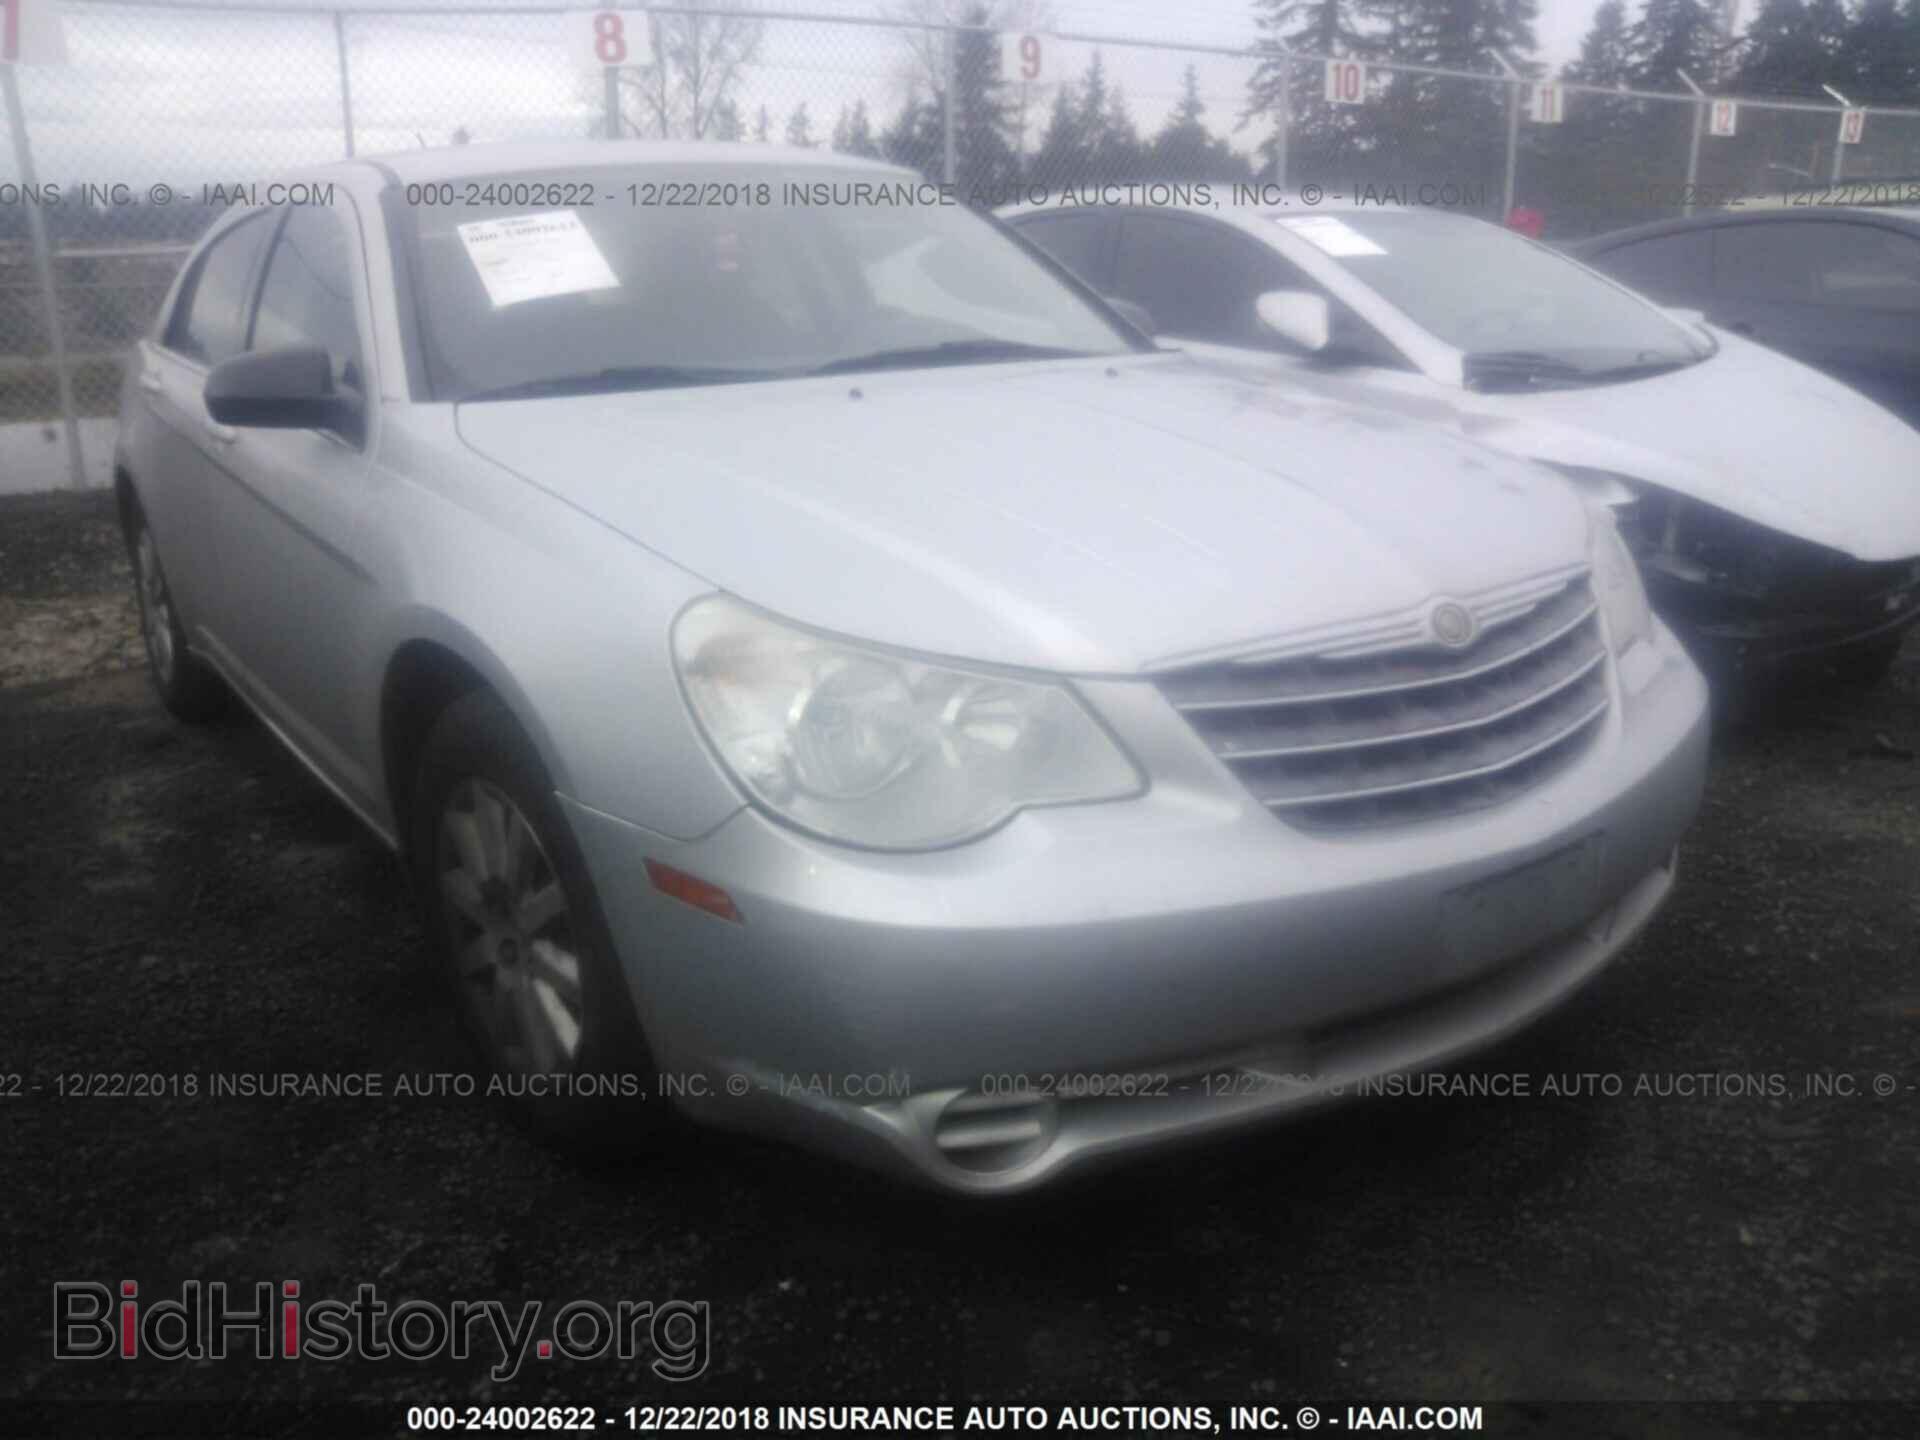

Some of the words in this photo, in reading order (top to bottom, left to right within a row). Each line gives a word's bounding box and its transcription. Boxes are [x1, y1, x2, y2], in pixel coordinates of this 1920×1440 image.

[594, 13, 626, 64] 8
[1020, 36, 1041, 80] 9
[1334, 63, 1360, 101] 10
